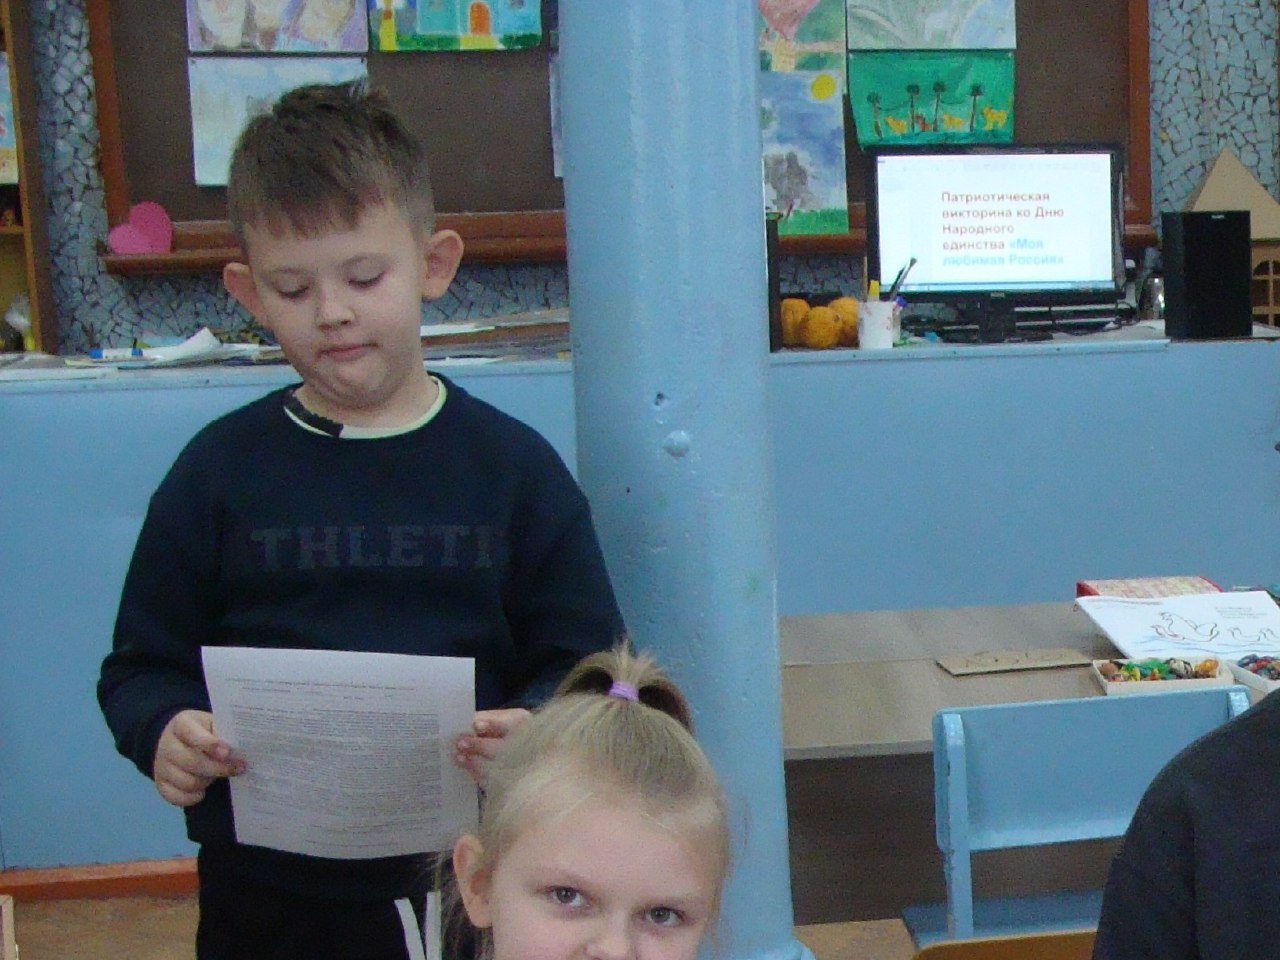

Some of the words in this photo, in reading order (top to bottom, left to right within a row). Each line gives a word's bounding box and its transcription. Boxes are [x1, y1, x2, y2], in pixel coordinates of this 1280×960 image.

[941, 191, 1050, 203] Патриотическая
[942, 208, 1012, 219] викторина
[1016, 208, 1031, 217] ко
[1034, 207, 1064, 218] Дню
[942, 224, 1015, 236] Народного
[943, 241, 1005, 251] единства
[943, 255, 1005, 267] любимая
